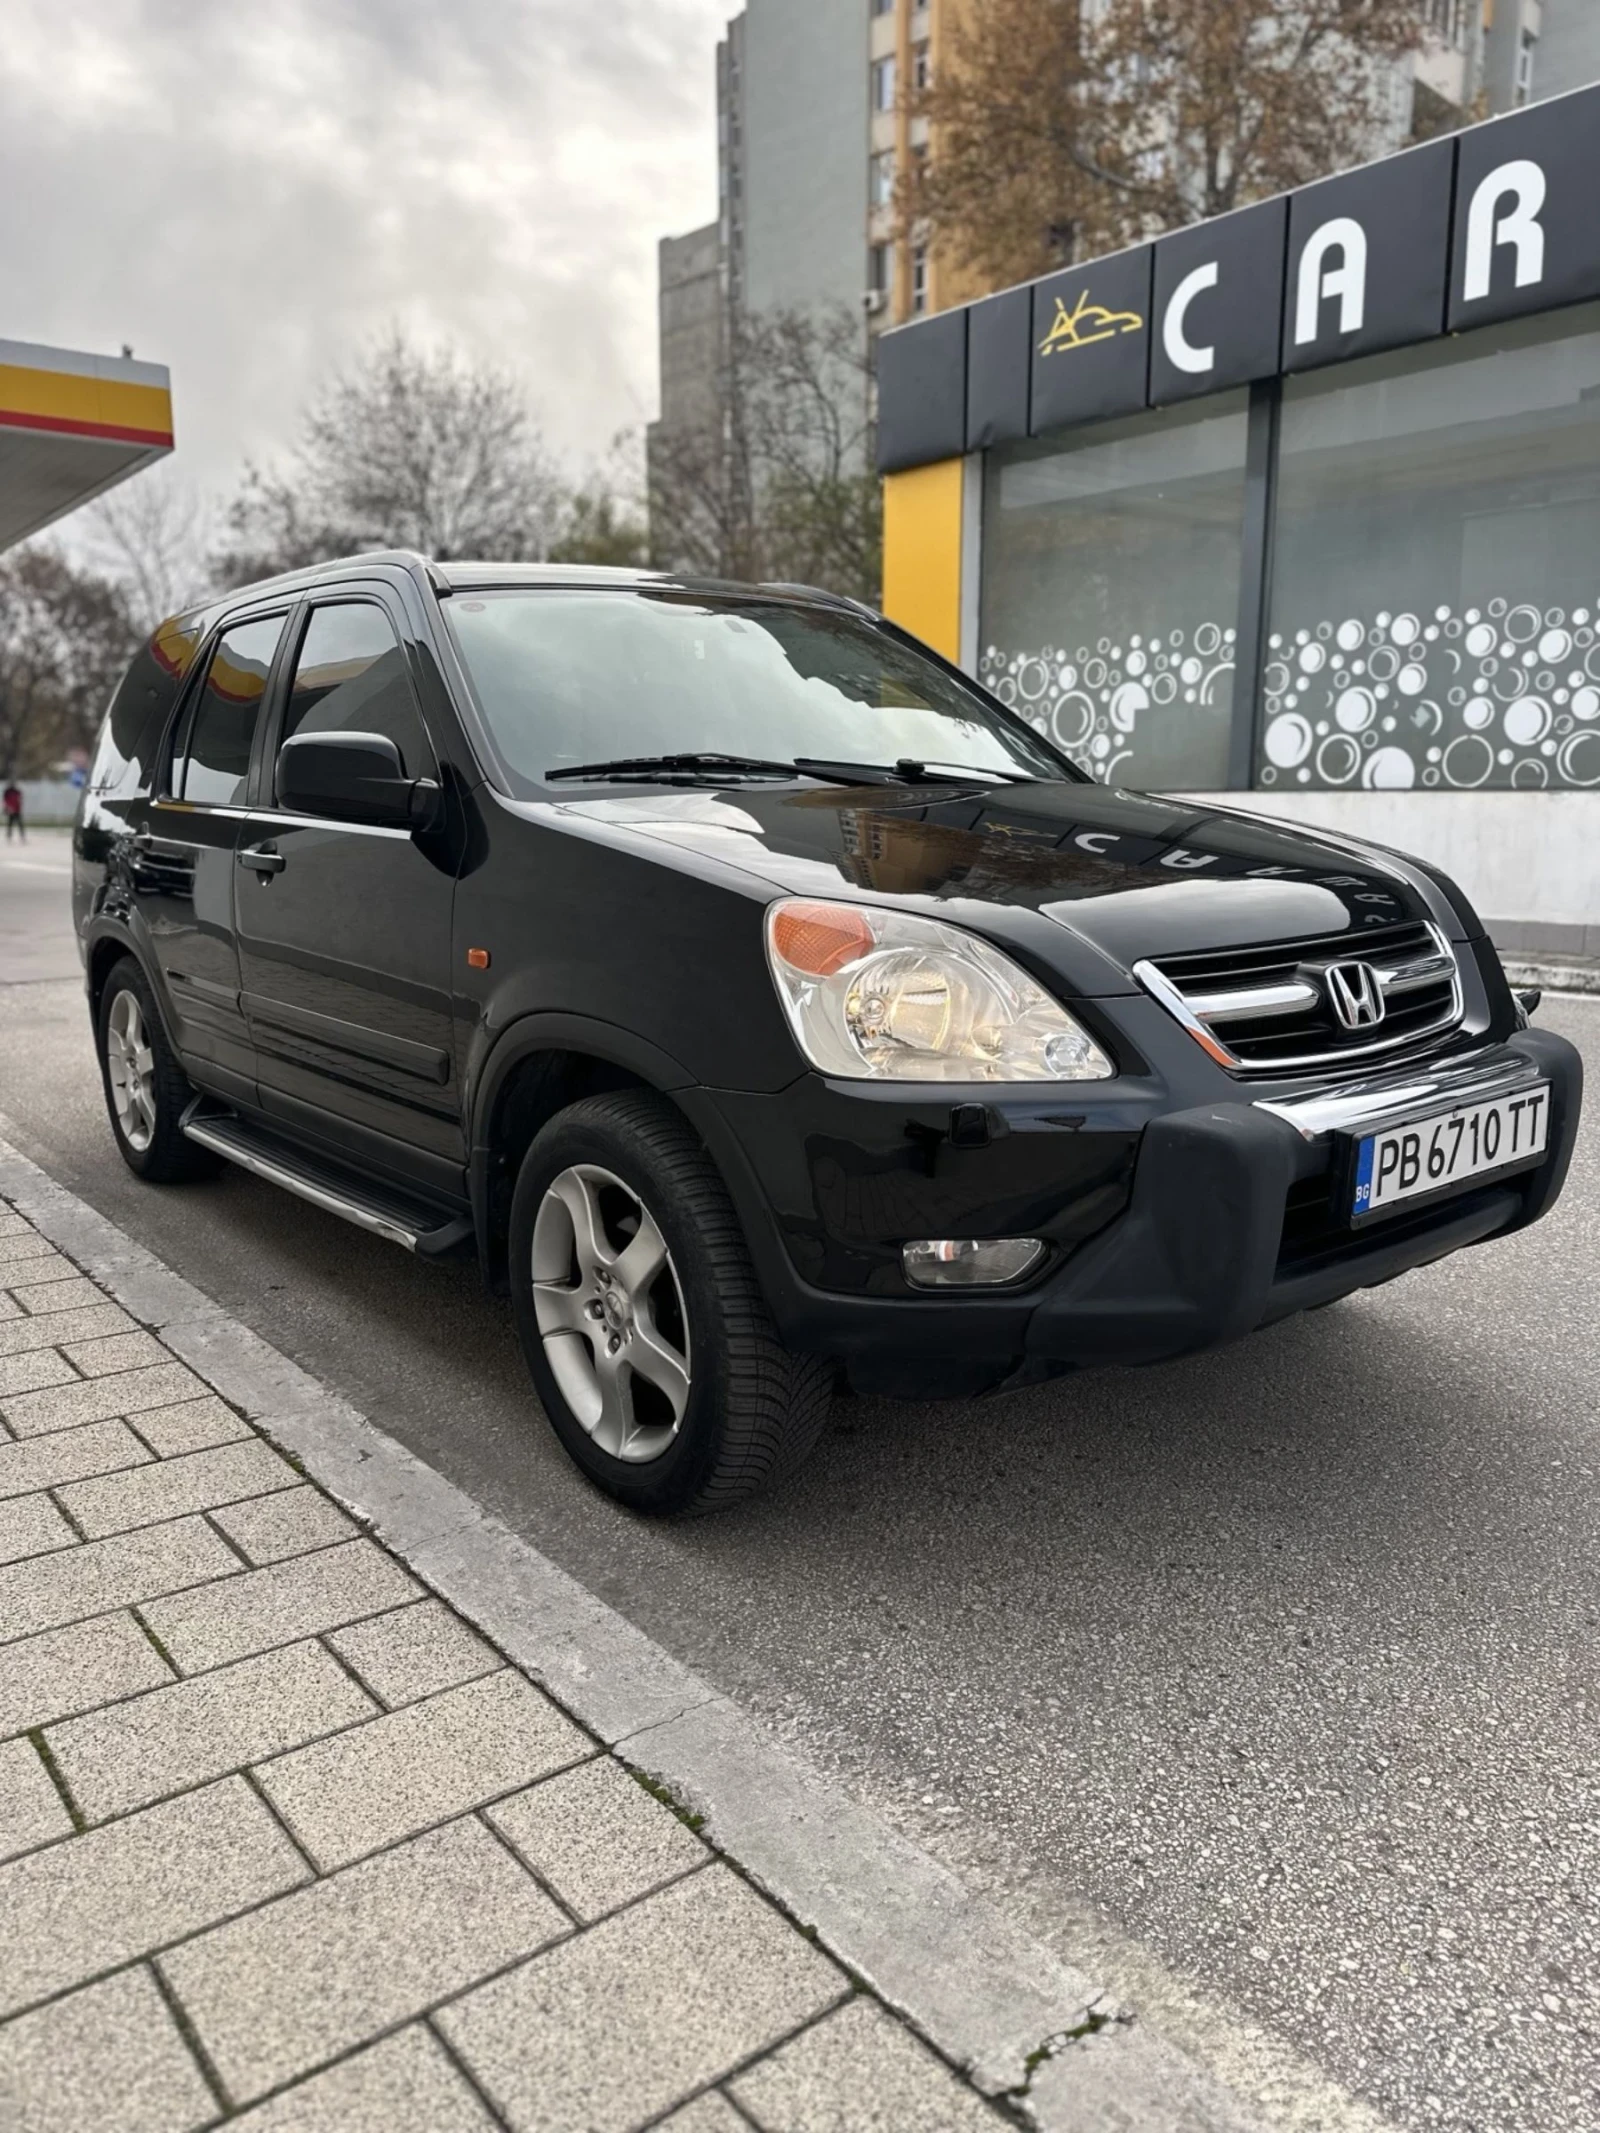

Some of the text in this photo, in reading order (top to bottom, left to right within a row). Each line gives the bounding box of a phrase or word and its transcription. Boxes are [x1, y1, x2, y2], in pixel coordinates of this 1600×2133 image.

[1163, 159, 1546, 374] CAR
[1356, 1183, 1370, 1202] BG
[1376, 1094, 1545, 1197] PB 6710 TT
